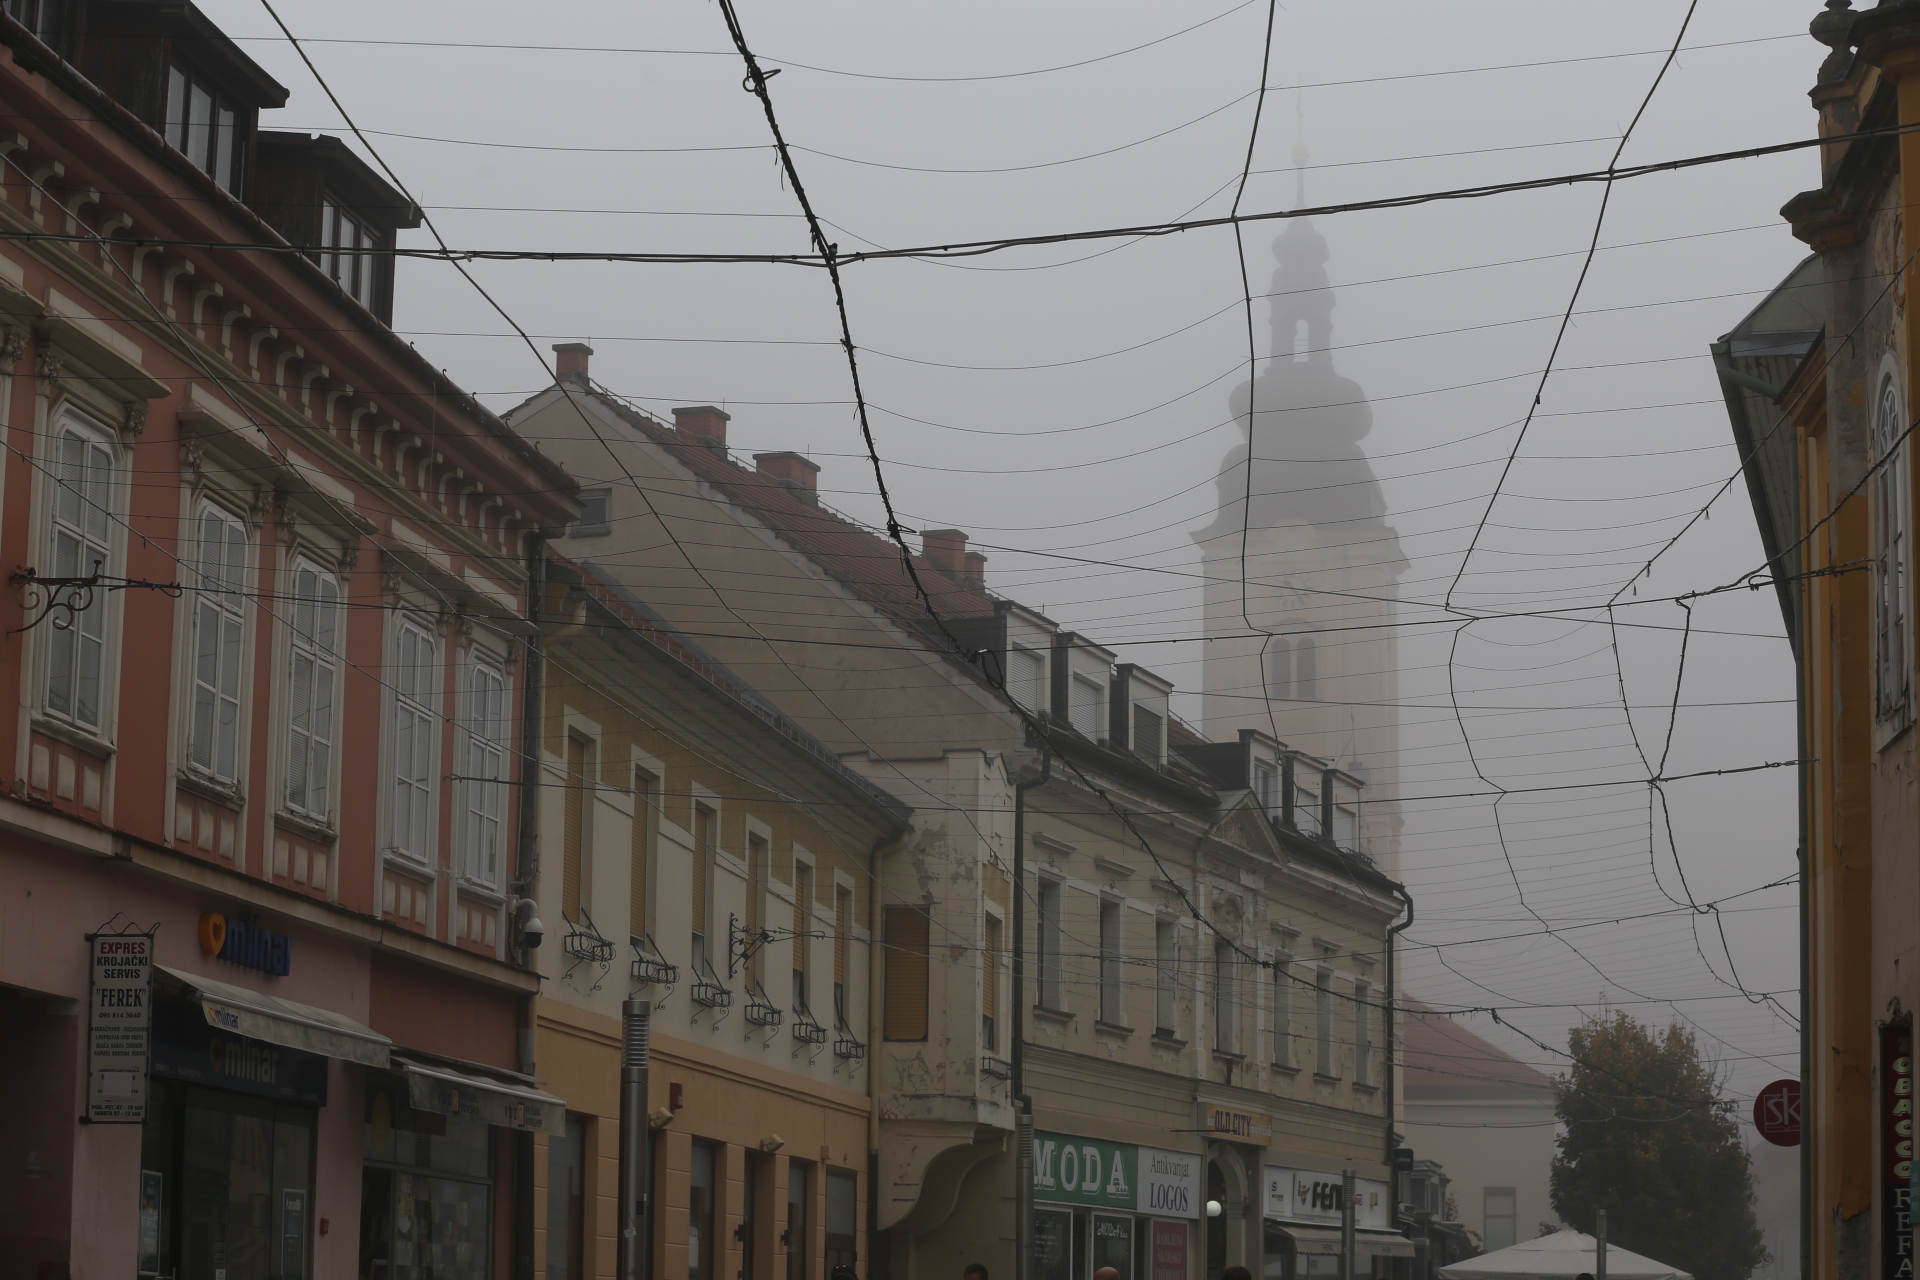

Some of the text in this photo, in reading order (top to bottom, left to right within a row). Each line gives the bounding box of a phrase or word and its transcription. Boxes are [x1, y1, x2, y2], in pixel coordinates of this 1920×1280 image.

[100, 942, 145, 954] EXPRES
[223, 912, 295, 976] mlinar
[97, 955, 148, 966] KROJAČKI
[104, 969, 140, 978] SERVIS
[215, 1006, 238, 1030] mlinar
[225, 1036, 279, 1084] mlinar
[1215, 1110, 1231, 1134] OLD
[1233, 1112, 1252, 1138] CITY
[1033, 1138, 1129, 1199] MODA
[1150, 1154, 1189, 1182] Antikvarijat
[1150, 1182, 1189, 1213] LOGOS
